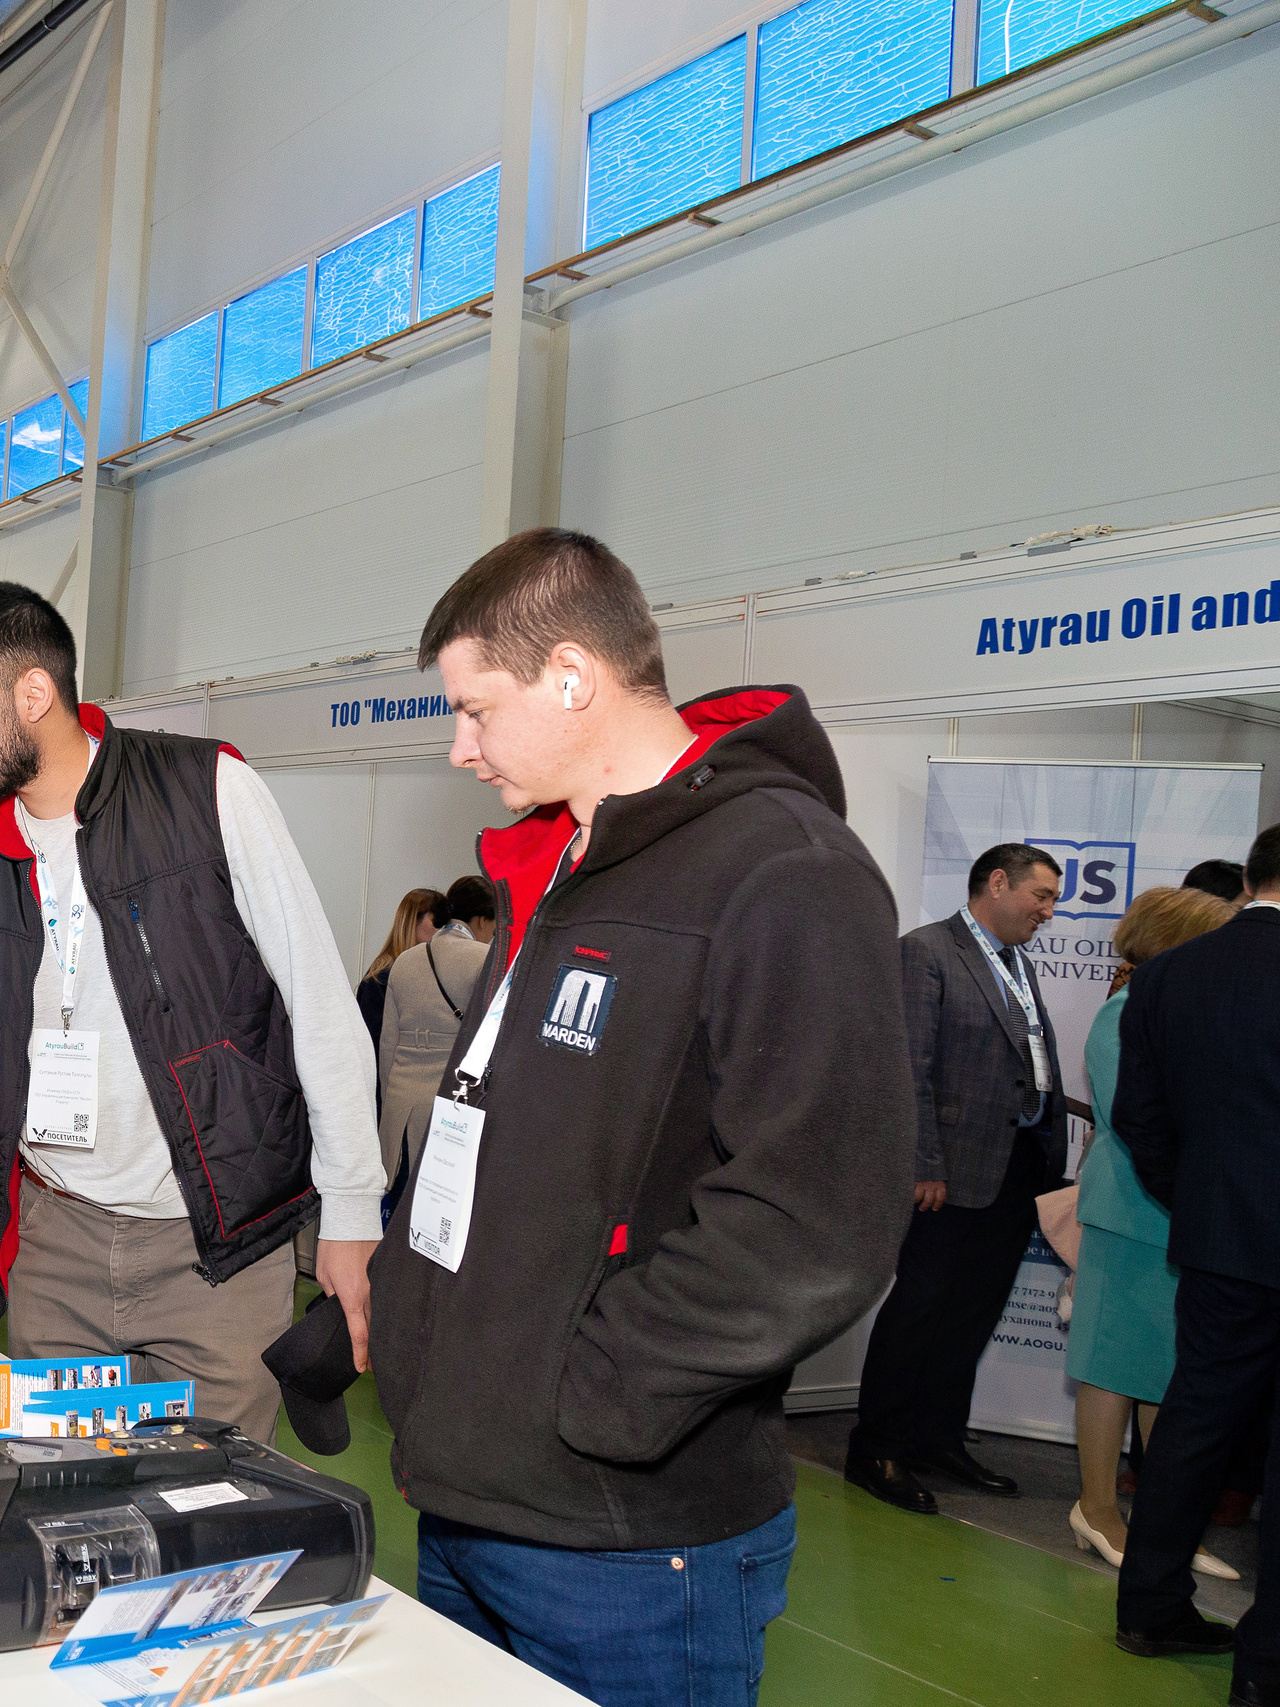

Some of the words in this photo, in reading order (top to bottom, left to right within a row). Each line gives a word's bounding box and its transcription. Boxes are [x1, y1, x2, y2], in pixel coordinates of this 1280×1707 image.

[976, 609, 1110, 656] Atyrau
[1121, 593, 1180, 639] Oil
[1191, 580, 1280, 632] and
[330, 701, 361, 728] ТОО
[1075, 939, 1122, 959] OIL
[45, 1042, 78, 1050] AtyrauBuild
[47, 1132, 88, 1143] ПОСЕТИТЕЛЬ
[82, 1574, 97, 1582] max
